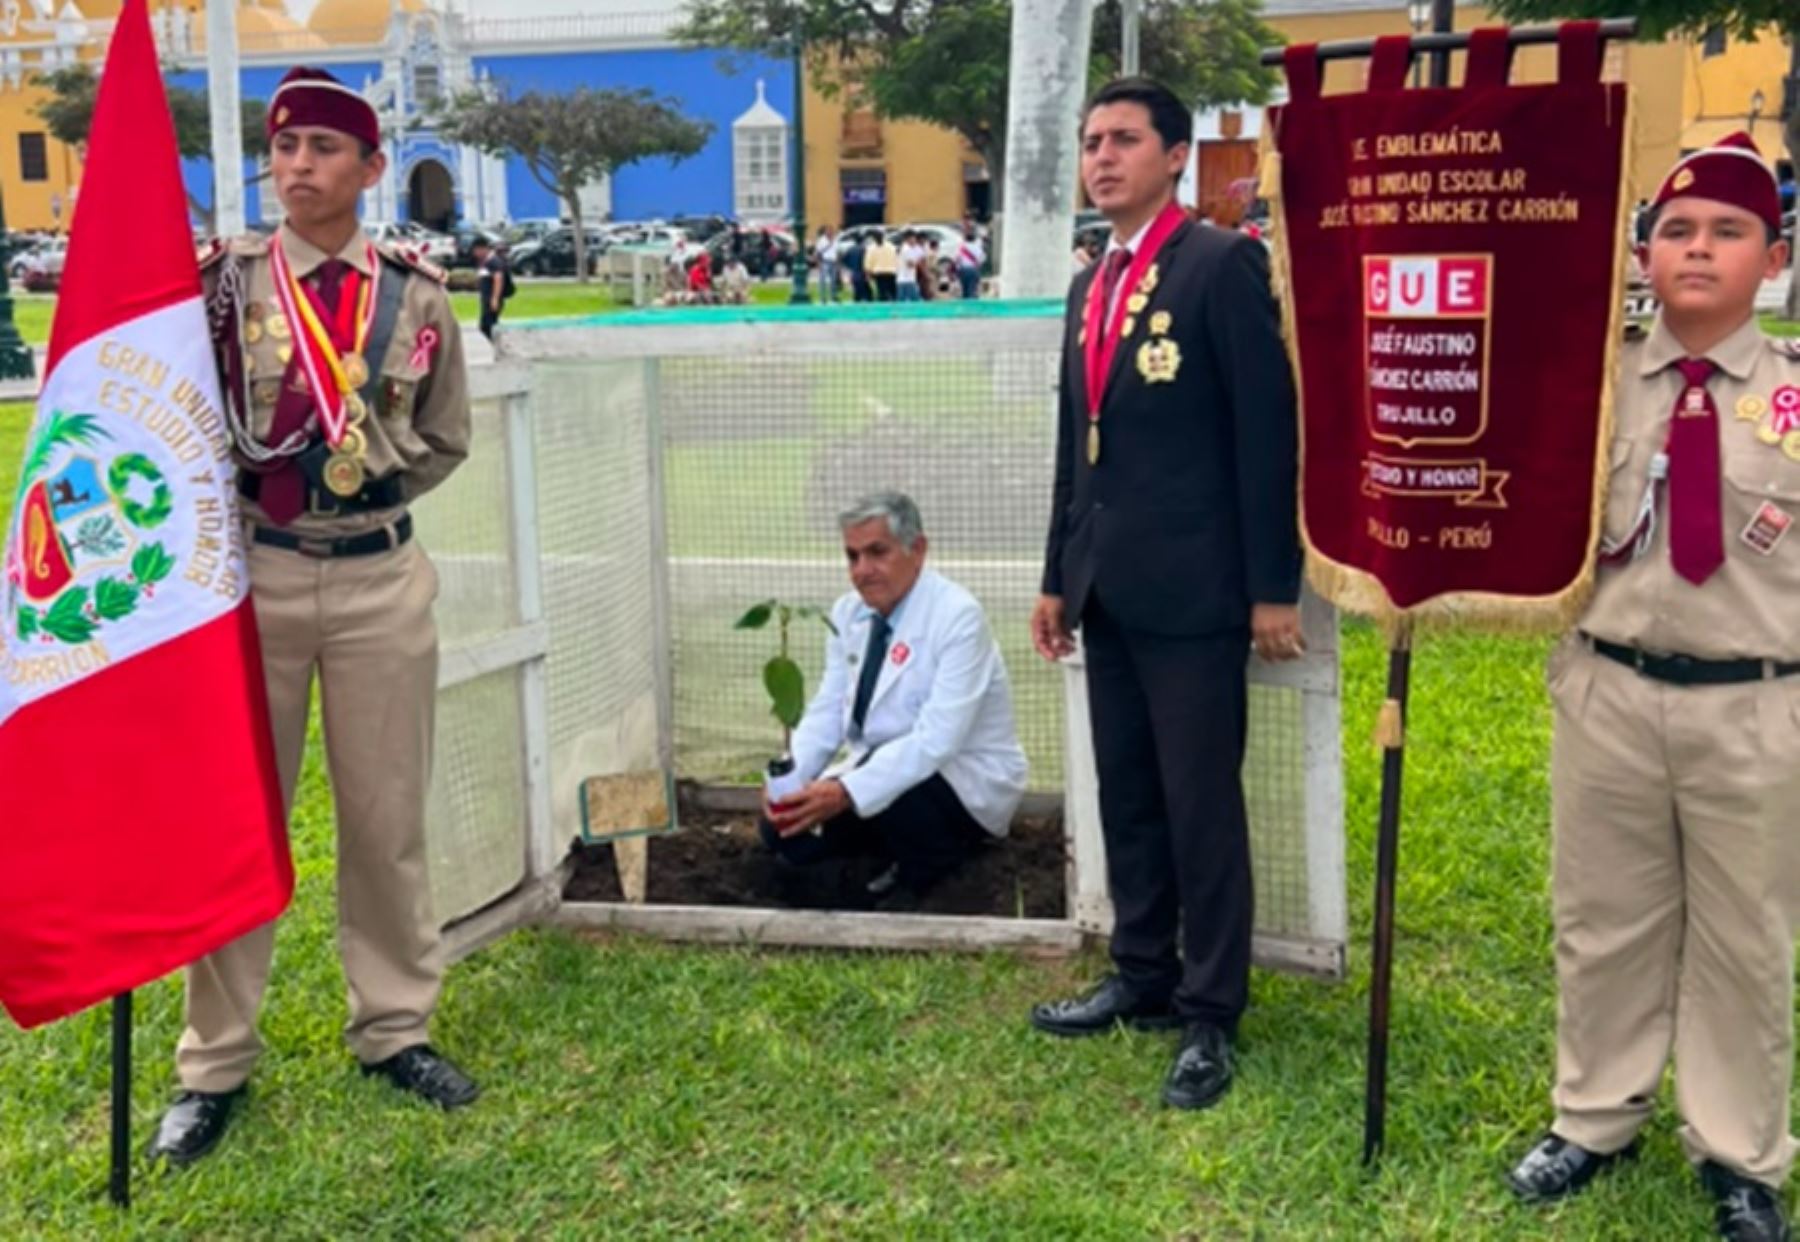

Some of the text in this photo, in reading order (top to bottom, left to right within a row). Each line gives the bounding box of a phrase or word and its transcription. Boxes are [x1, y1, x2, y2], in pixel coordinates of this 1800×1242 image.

[1376, 125, 1502, 158] EMBLEMÁTICA
[1438, 168, 1527, 193] ESCOLAR
[1406, 193, 1489, 223] SÁNCHEZ
[1497, 191, 1579, 222] CARRIÓN
[1394, 332, 1476, 357] FAUSTINO
[97, 340, 171, 390] GRAN
[1410, 361, 1479, 392] CARRIÓN
[97, 378, 222, 588] ESTUDIO Y HONOR
[1406, 467, 1417, 486] Y
[1421, 466, 1479, 488] HONOR
[1439, 520, 1491, 549] PERÚ
